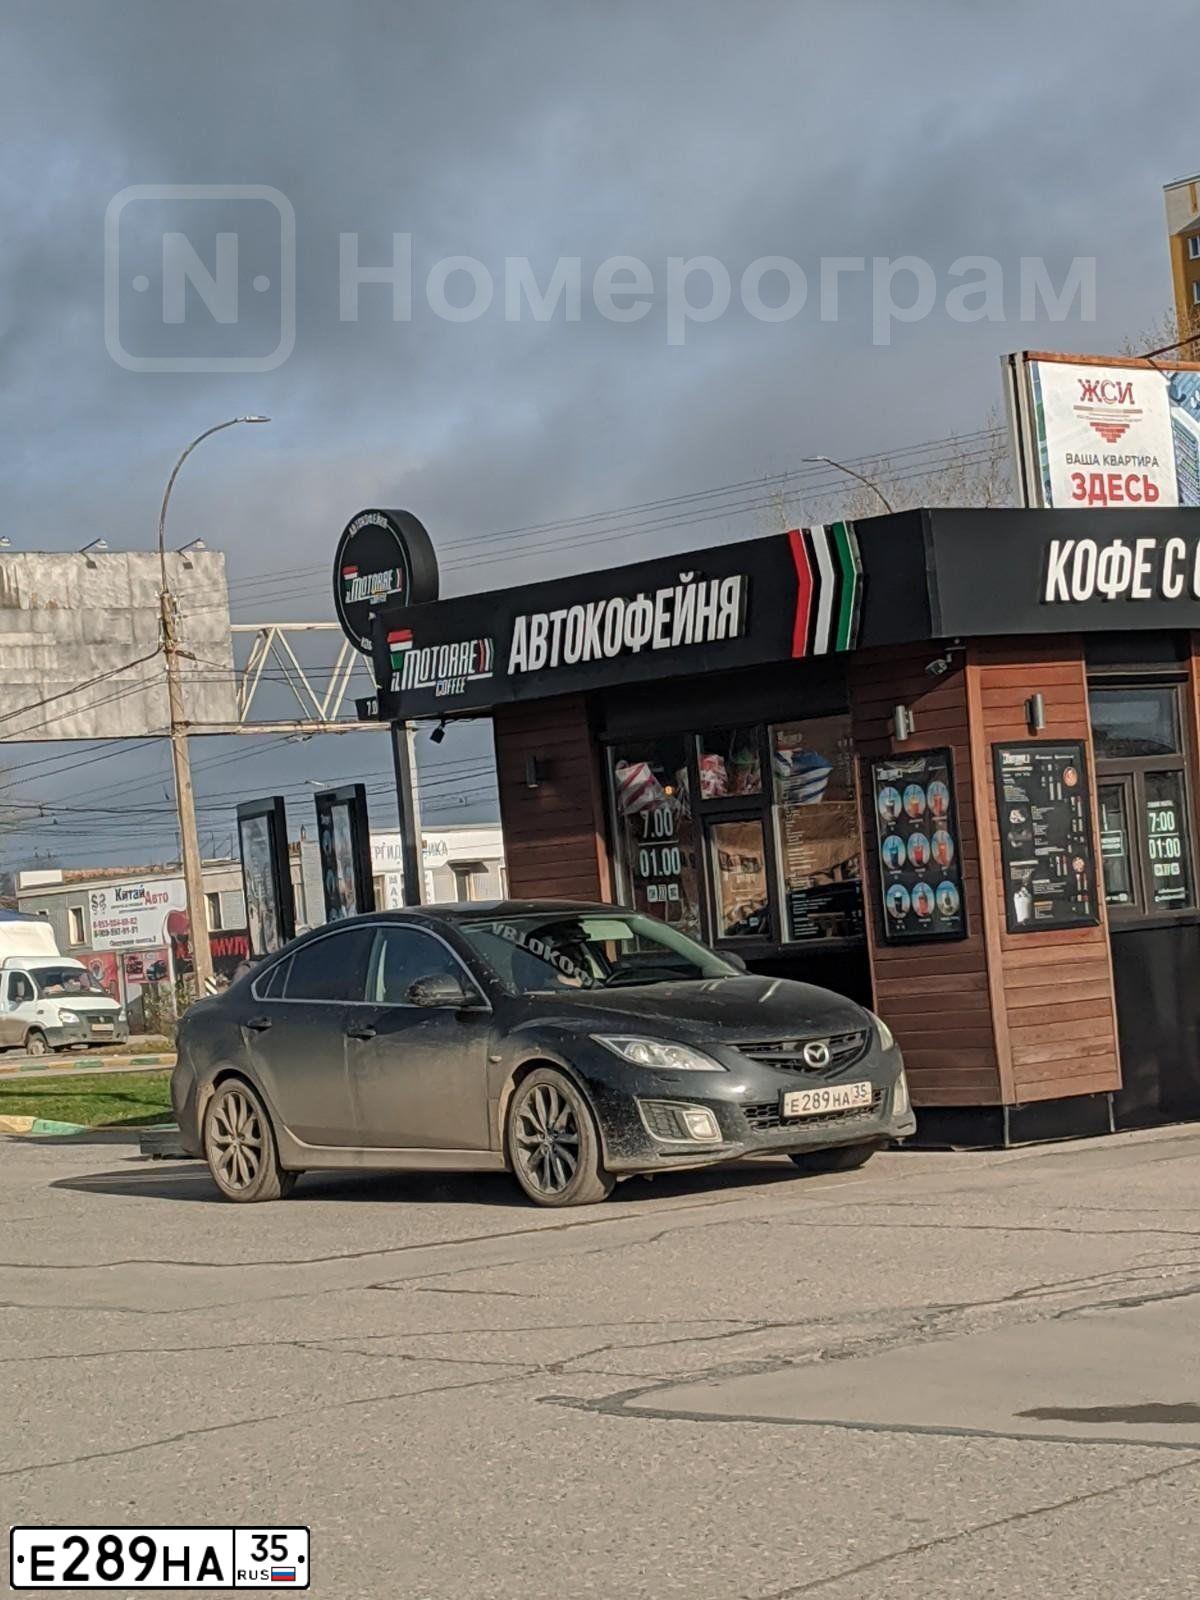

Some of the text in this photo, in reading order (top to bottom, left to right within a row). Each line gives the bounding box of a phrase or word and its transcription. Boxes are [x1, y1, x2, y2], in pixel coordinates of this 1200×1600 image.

[1078, 379, 1135, 405] ЖСИ
[1065, 453, 1160, 468] ВАША КВАРТИРА
[1071, 472, 1160, 506] ЗДЕСЬ
[1045, 538, 1157, 602] КОФЕ
[1161, 537, 1186, 599] С
[507, 571, 742, 676] АВТОКОФЕЙНЯ
[401, 640, 480, 690] MOTORRE
[435, 677, 468, 697] COFFEE
[1148, 811, 1176, 833] 7:00
[1148, 837, 1181, 859] 01:00
[115, 884, 146, 902] Китай
[144, 890, 169, 906] Авто
[790, 1084, 868, 1113] Е289НА 35
